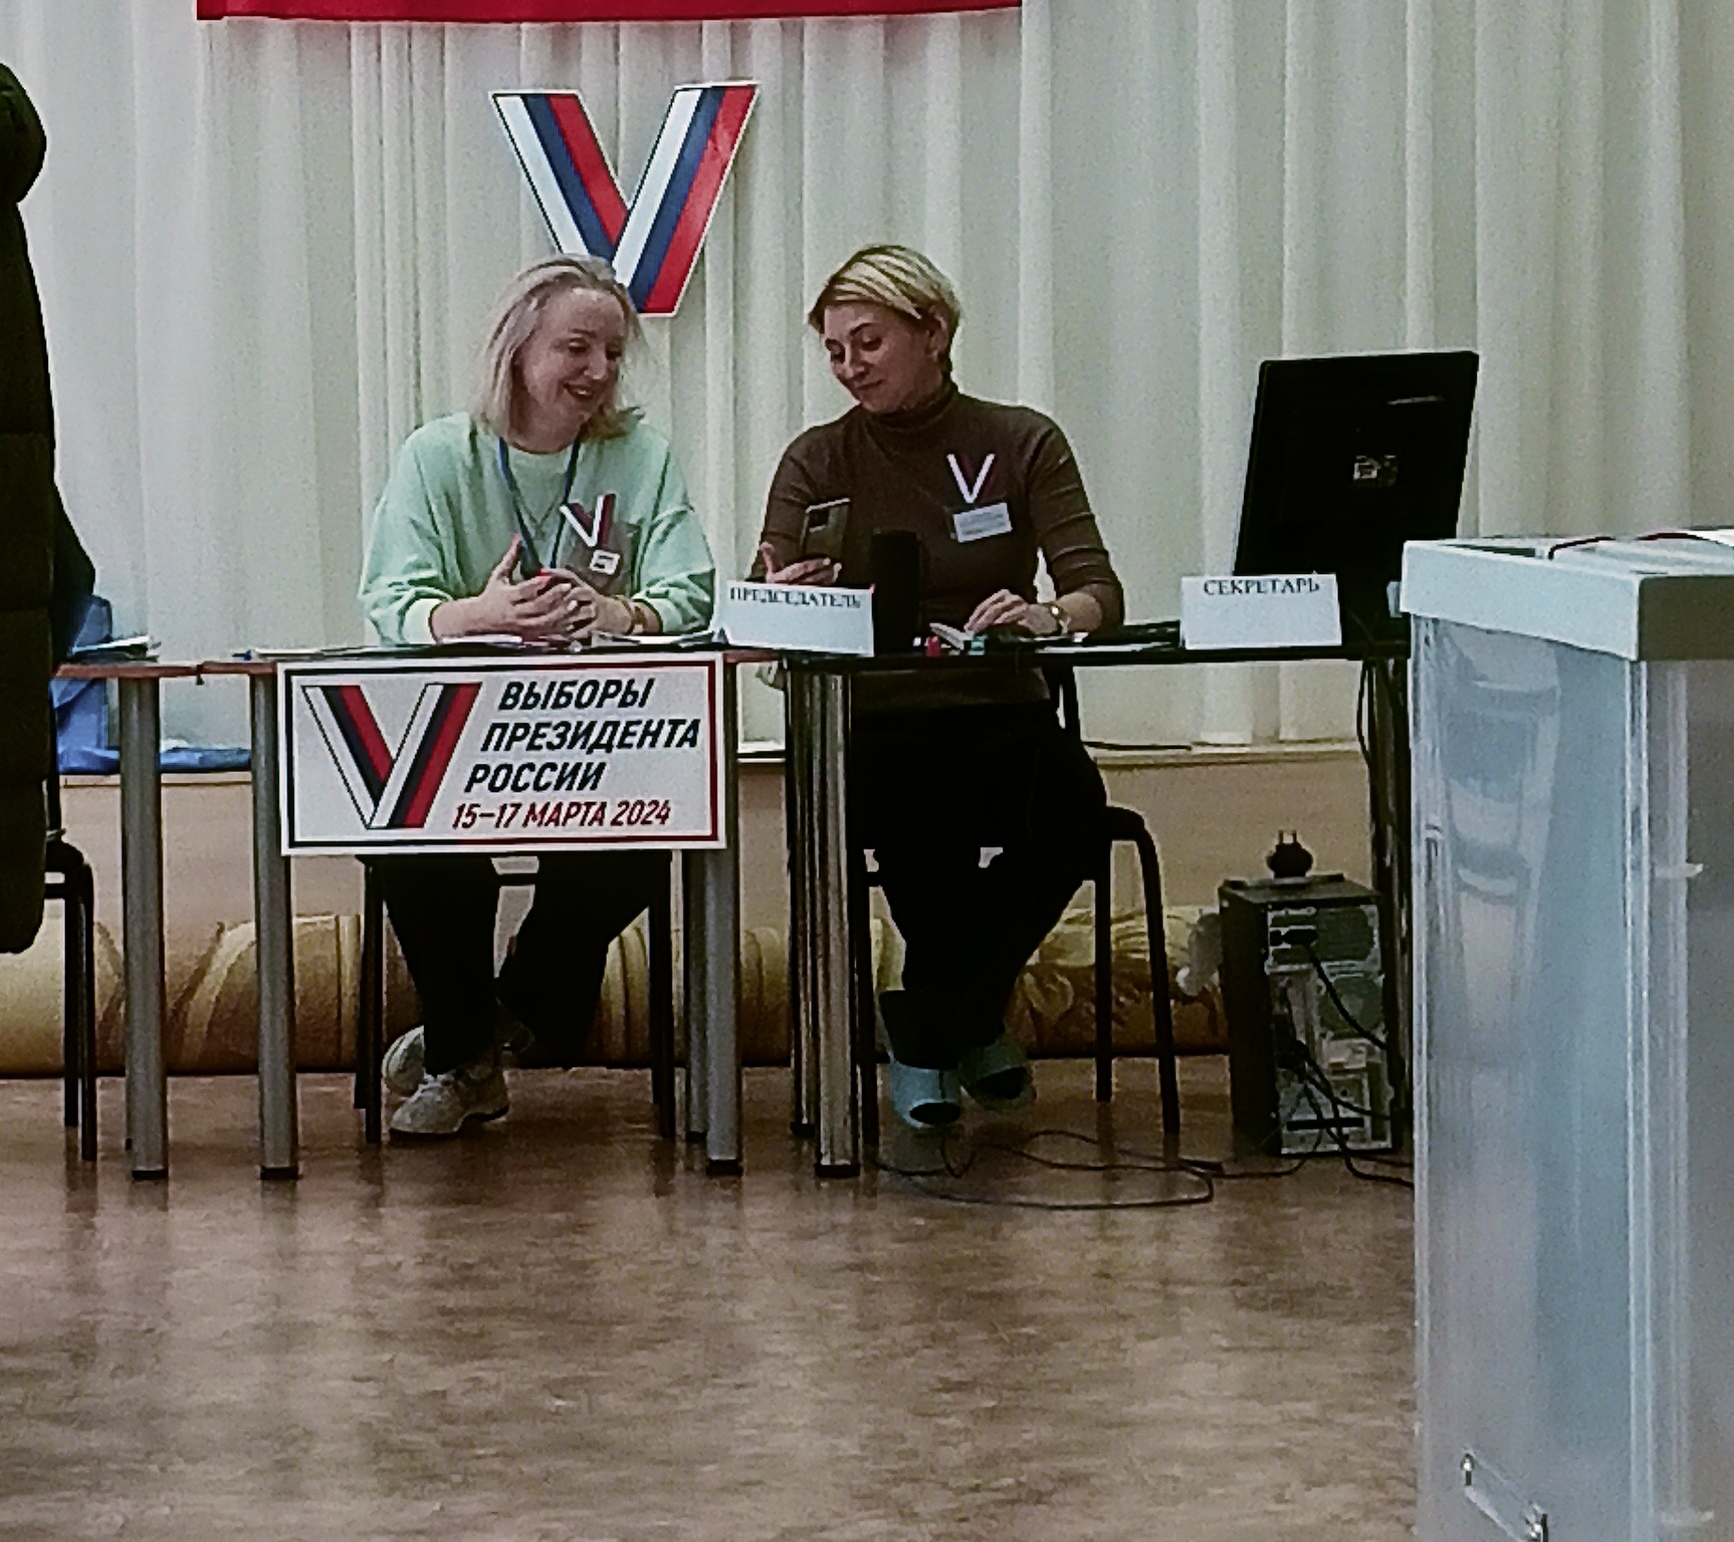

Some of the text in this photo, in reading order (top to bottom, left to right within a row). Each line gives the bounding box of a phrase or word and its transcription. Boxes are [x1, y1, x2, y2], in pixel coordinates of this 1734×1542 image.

[488, 78, 761, 318] V
[729, 586, 862, 609] ПРЕДСЕДАТЕЛЬ
[1203, 577, 1321, 596] СЕКРЕТАРЬ
[497, 677, 656, 710] ВЫБОРЫ
[480, 718, 702, 755] ПРЕЗИДЕНТА
[301, 681, 483, 830] V
[463, 761, 608, 793] РОССИИ
[522, 800, 608, 828] МАРТА
[609, 799, 672, 827] 2024
